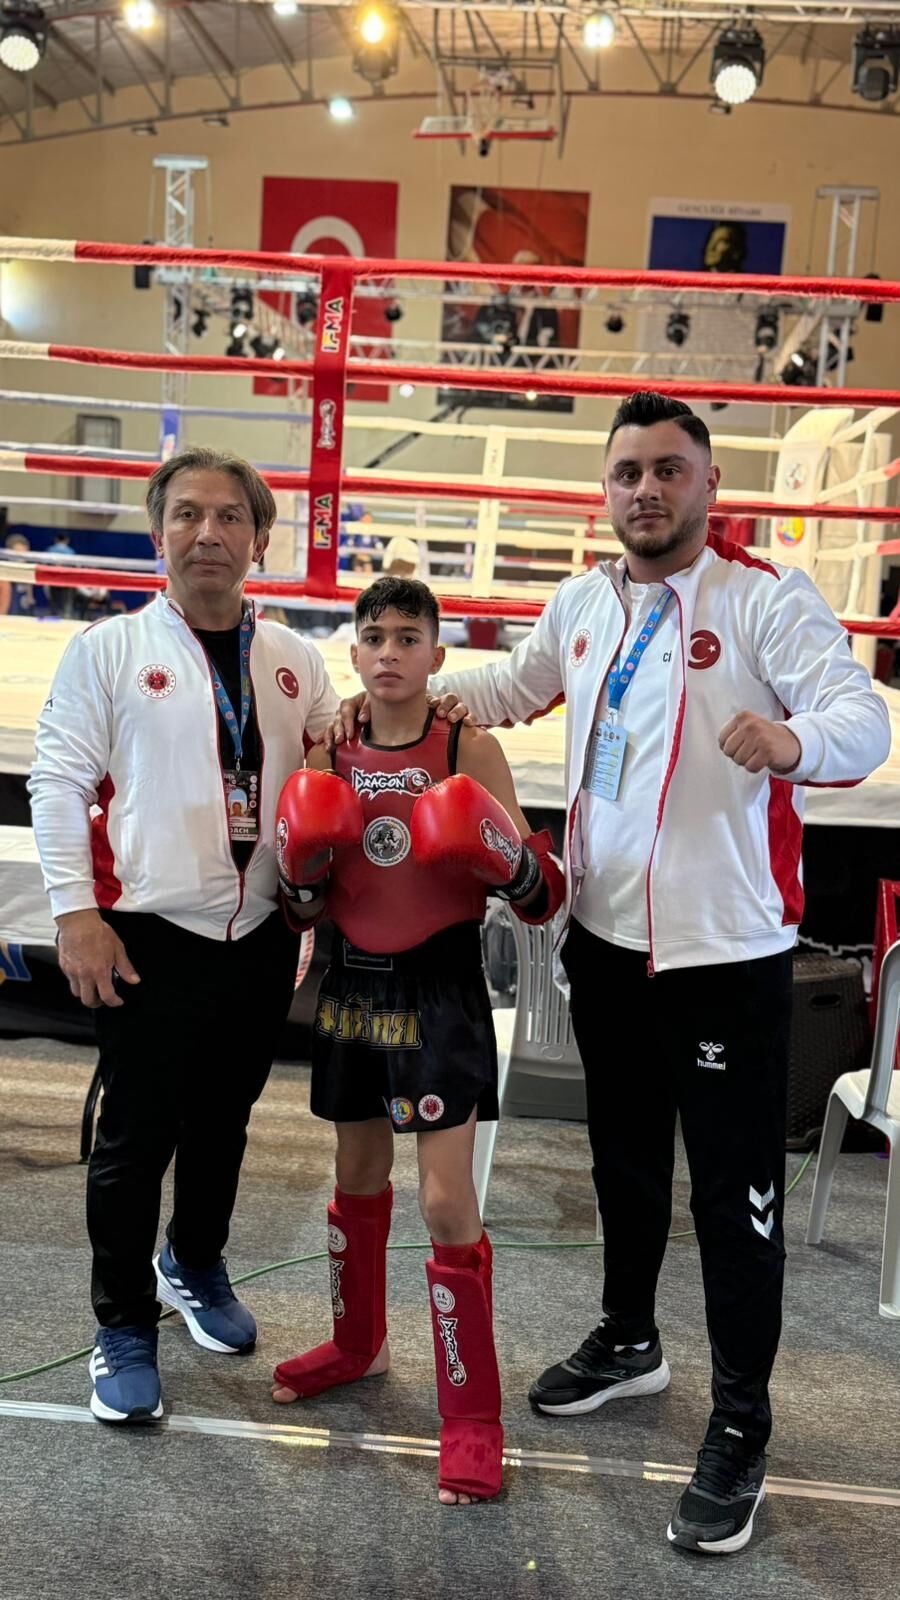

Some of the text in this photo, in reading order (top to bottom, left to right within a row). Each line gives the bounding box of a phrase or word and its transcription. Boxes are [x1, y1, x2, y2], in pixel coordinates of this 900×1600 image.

[322, 297, 343, 352] IFMA
[314, 494, 332, 549] IFMA
[352, 769, 406, 795] DRAGON
[697, 1057, 726, 1071] hummel
[439, 1317, 458, 1368] DRAGON
